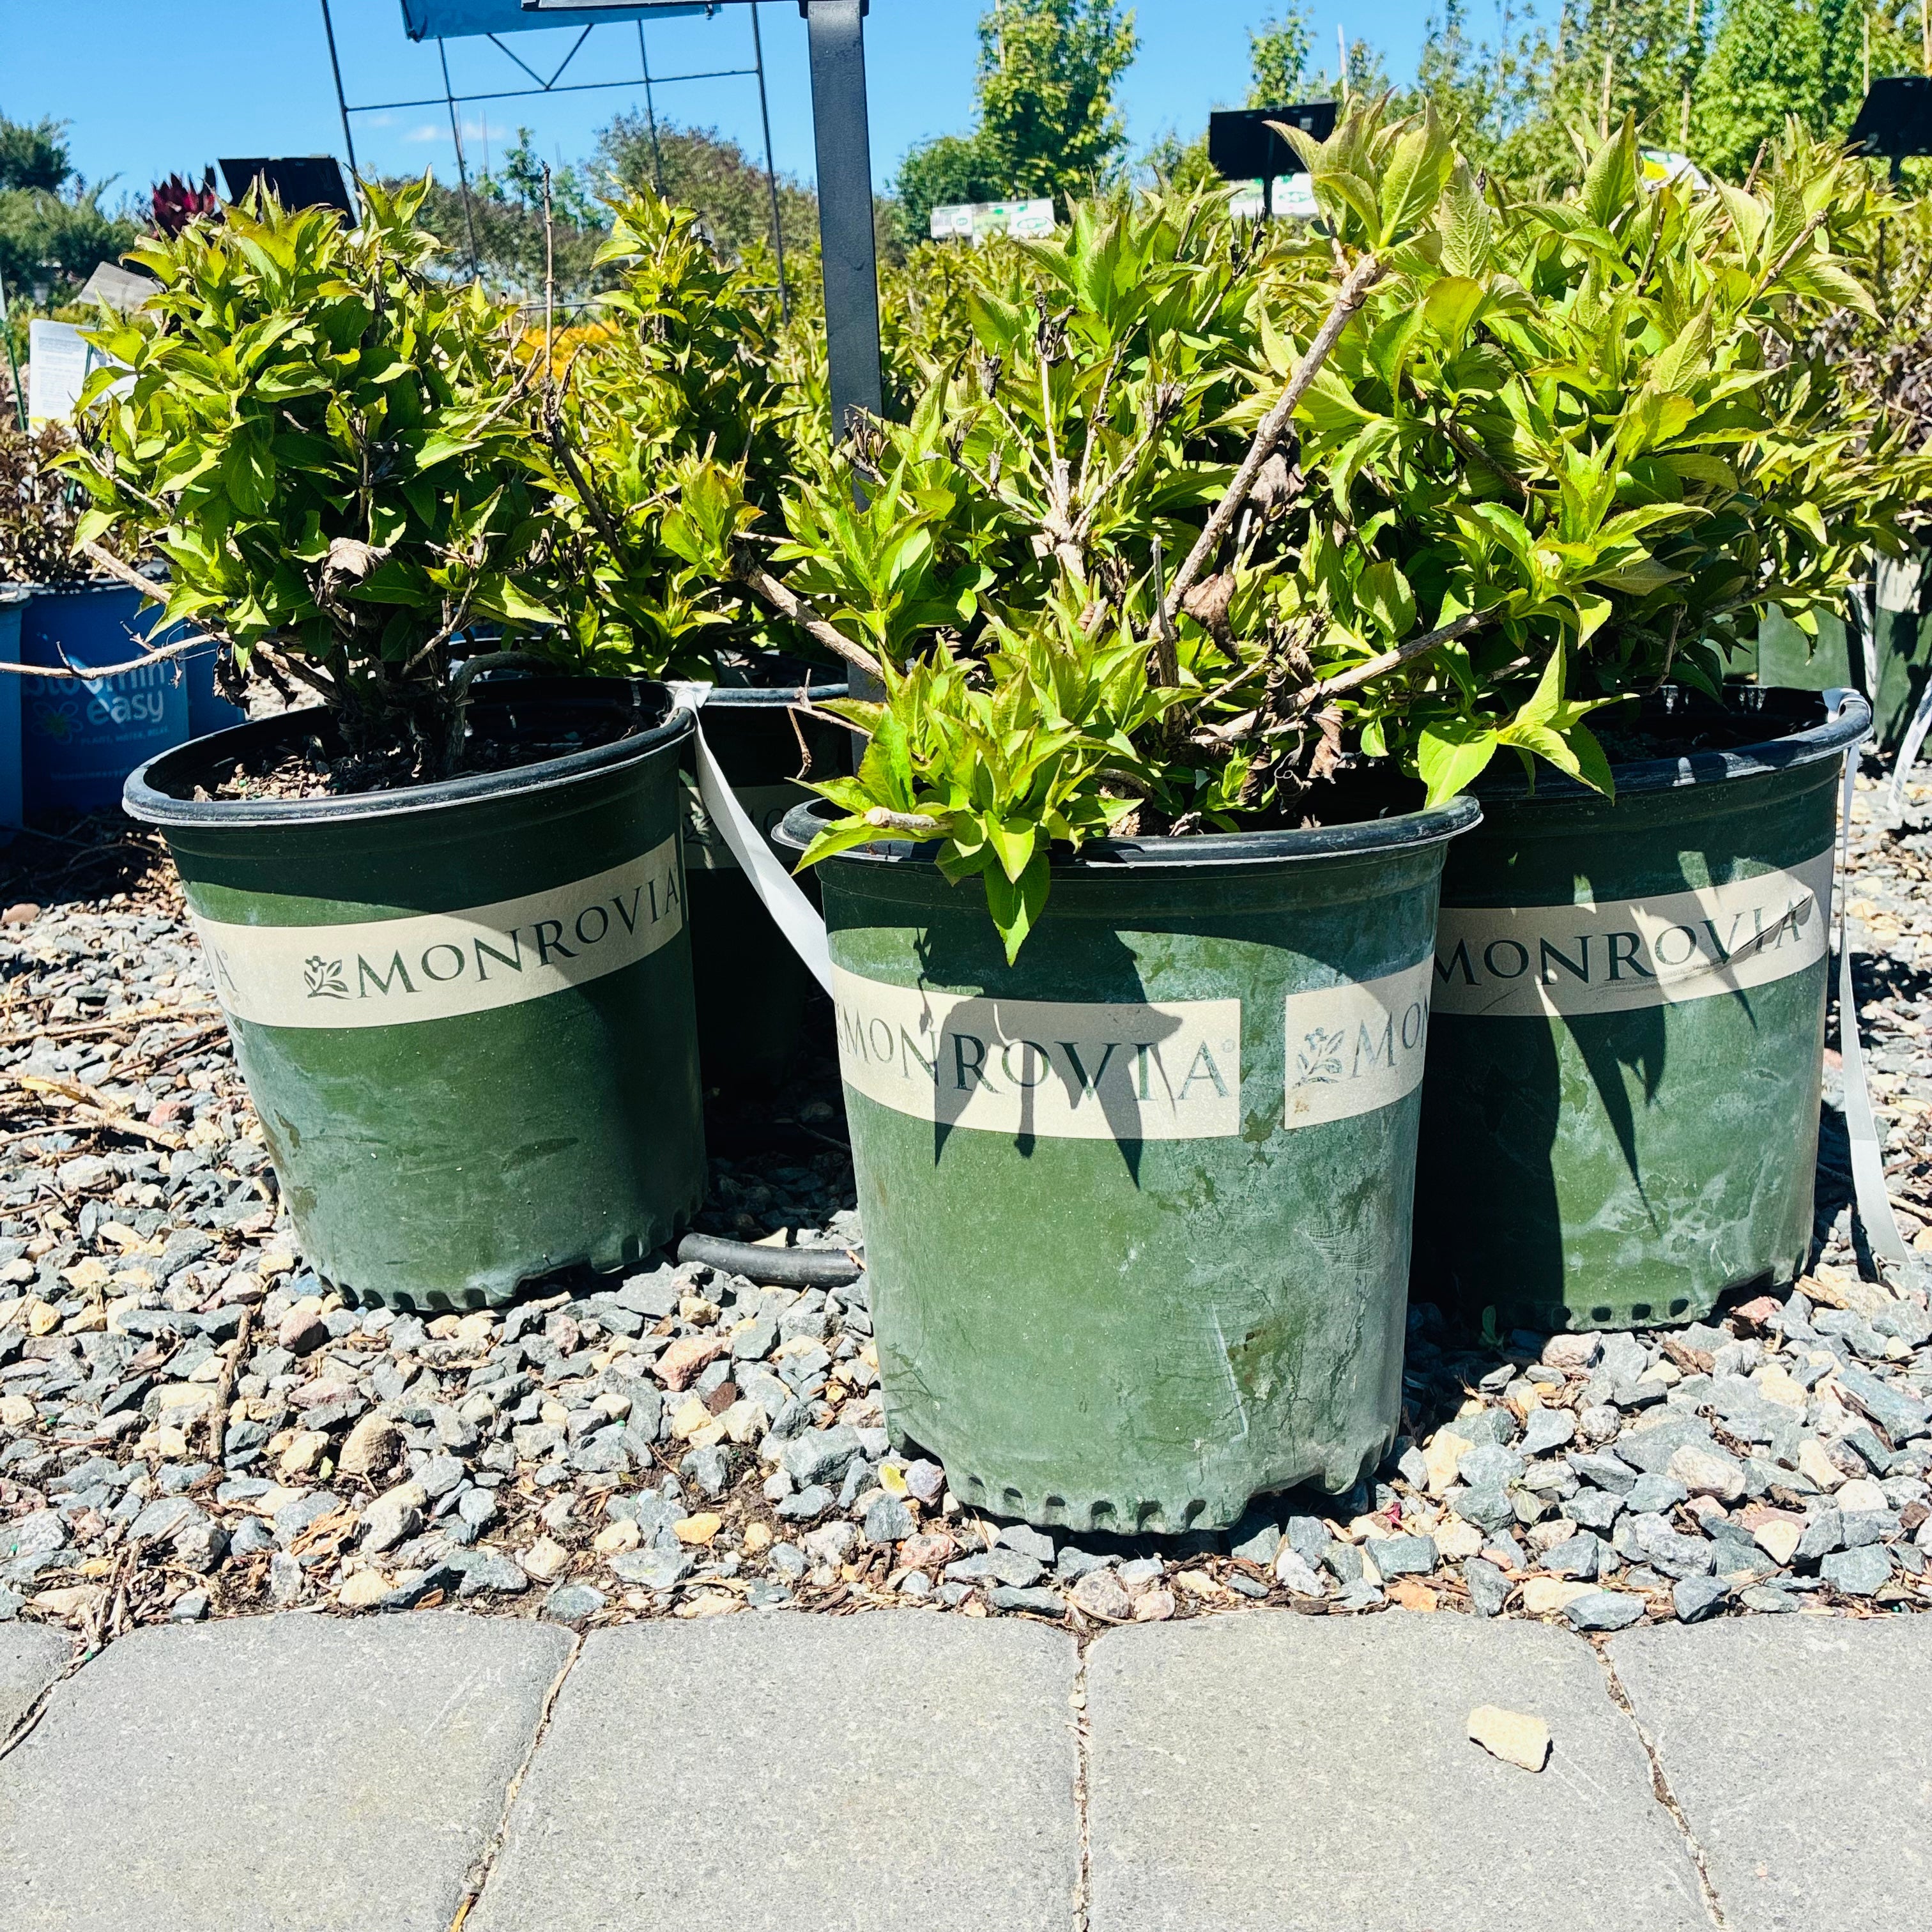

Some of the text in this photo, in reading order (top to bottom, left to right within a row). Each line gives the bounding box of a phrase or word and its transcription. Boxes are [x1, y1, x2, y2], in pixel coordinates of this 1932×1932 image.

[88, 691, 163, 726] easy
[357, 867, 679, 999] MONROVIA
[1434, 900, 1802, 986] MONROVIA
[843, 1002, 1232, 1102] MONROVIA
